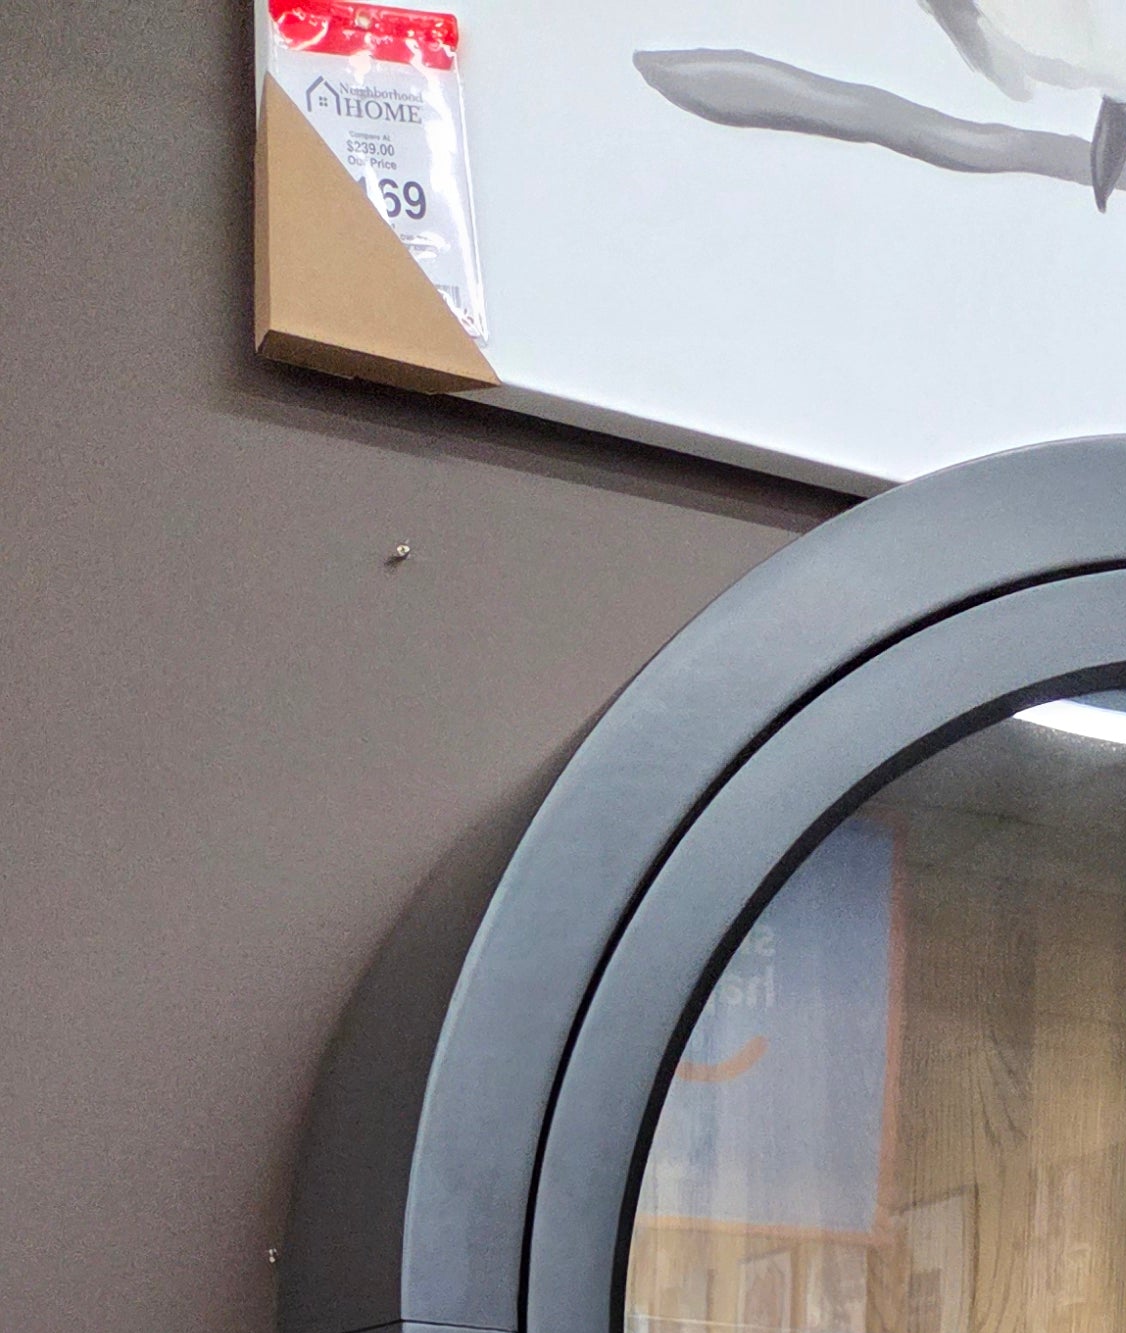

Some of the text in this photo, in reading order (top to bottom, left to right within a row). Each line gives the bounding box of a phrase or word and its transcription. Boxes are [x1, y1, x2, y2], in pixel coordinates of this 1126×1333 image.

[344, 98, 422, 124] HOME
[346, 140, 395, 156] $239.00
[370, 157, 397, 170] Price
